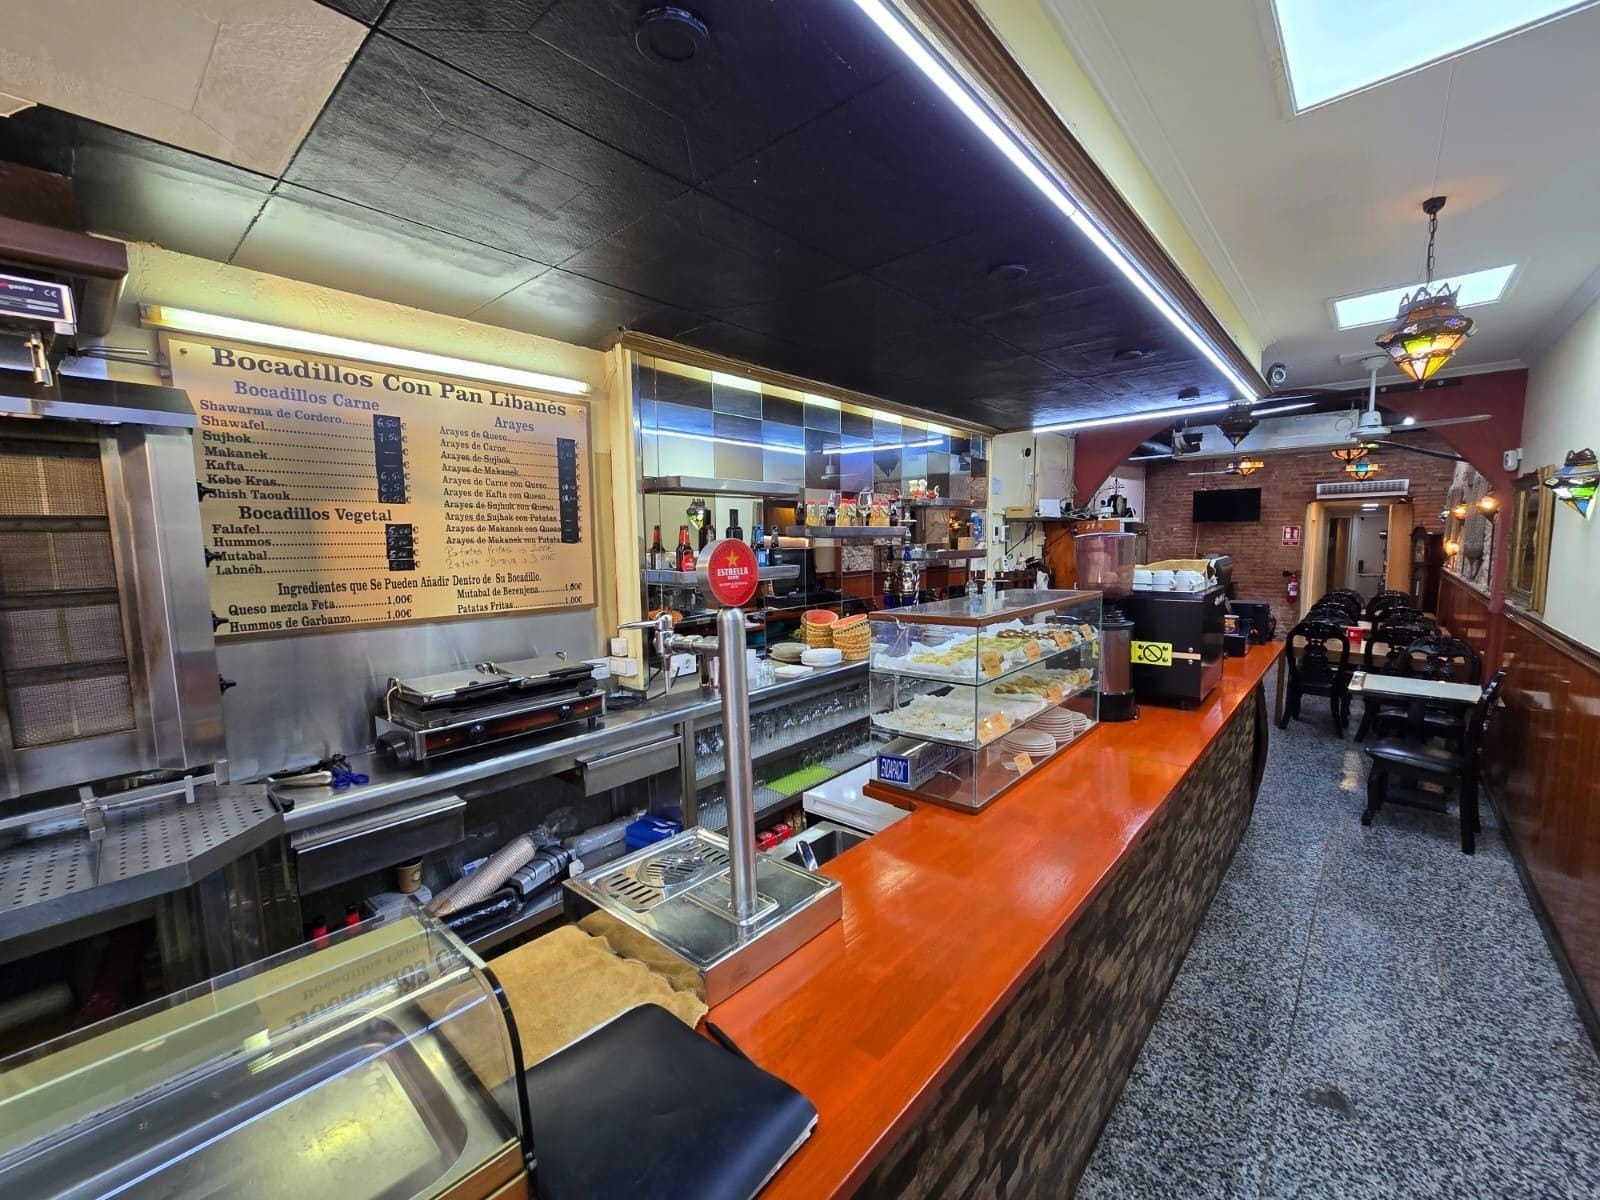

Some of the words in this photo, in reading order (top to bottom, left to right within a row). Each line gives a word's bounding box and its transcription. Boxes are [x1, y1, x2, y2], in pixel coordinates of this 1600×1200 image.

[211, 346, 373, 388] Bocadillos
[382, 373, 432, 397] Con
[439, 382, 483, 404] Pan
[490, 390, 567, 416] Libanés
[234, 380, 327, 404] Bocadillos
[333, 393, 379, 411] Carne
[200, 400, 272, 416] Shawarma
[277, 408, 291, 418] de
[294, 410, 342, 424] Cordero
[201, 415, 265, 430] Shawafel
[495, 416, 535, 433] Arayes
[202, 430, 251, 444] Sujhok
[440, 426, 468, 438] Arayes
[440, 438, 469, 450] Arayes
[471, 442, 481, 450] de
[204, 446, 268, 459] Makanek
[205, 460, 245, 471] Kafta
[207, 474, 240, 485] Kebe
[245, 476, 277, 487] Kras
[442, 475, 471, 486] Arayes
[473, 478, 482, 486] de
[208, 489, 247, 499] Shish
[250, 489, 291, 500] Taouk
[443, 487, 472, 498] Arayes
[474, 489, 483, 497] de
[238, 506, 330, 521] Bocadillos
[335, 508, 392, 524] Vegetal
[212, 524, 260, 534] Falafel
[213, 537, 271, 547] Hummos
[215, 550, 267, 561] Mutabal
[216, 563, 262, 575] Labnéh
[717, 567, 749, 577] ESTRELLA
[277, 581, 347, 598] Ingredientes
[350, 582, 368, 594] que
[370, 578, 382, 590] Se
[384, 577, 418, 590] Pueden
[420, 575, 449, 587] Añadir
[452, 574, 481, 586] Dentro
[482, 573, 492, 584] de
[495, 573, 505, 584] Su
[457, 588, 490, 599] Mutabal
[492, 587, 501, 596] de
[503, 586, 539, 596] Berenjena
[228, 604, 267, 616] Queso
[270, 601, 308, 613] mezcla
[311, 599, 335, 610] Feta
[457, 604, 489, 613] Patatas
[490, 601, 513, 611] Fritas
[230, 620, 282, 632] Hummos
[285, 617, 299, 628] de
[301, 614, 351, 627] Garbanzo
